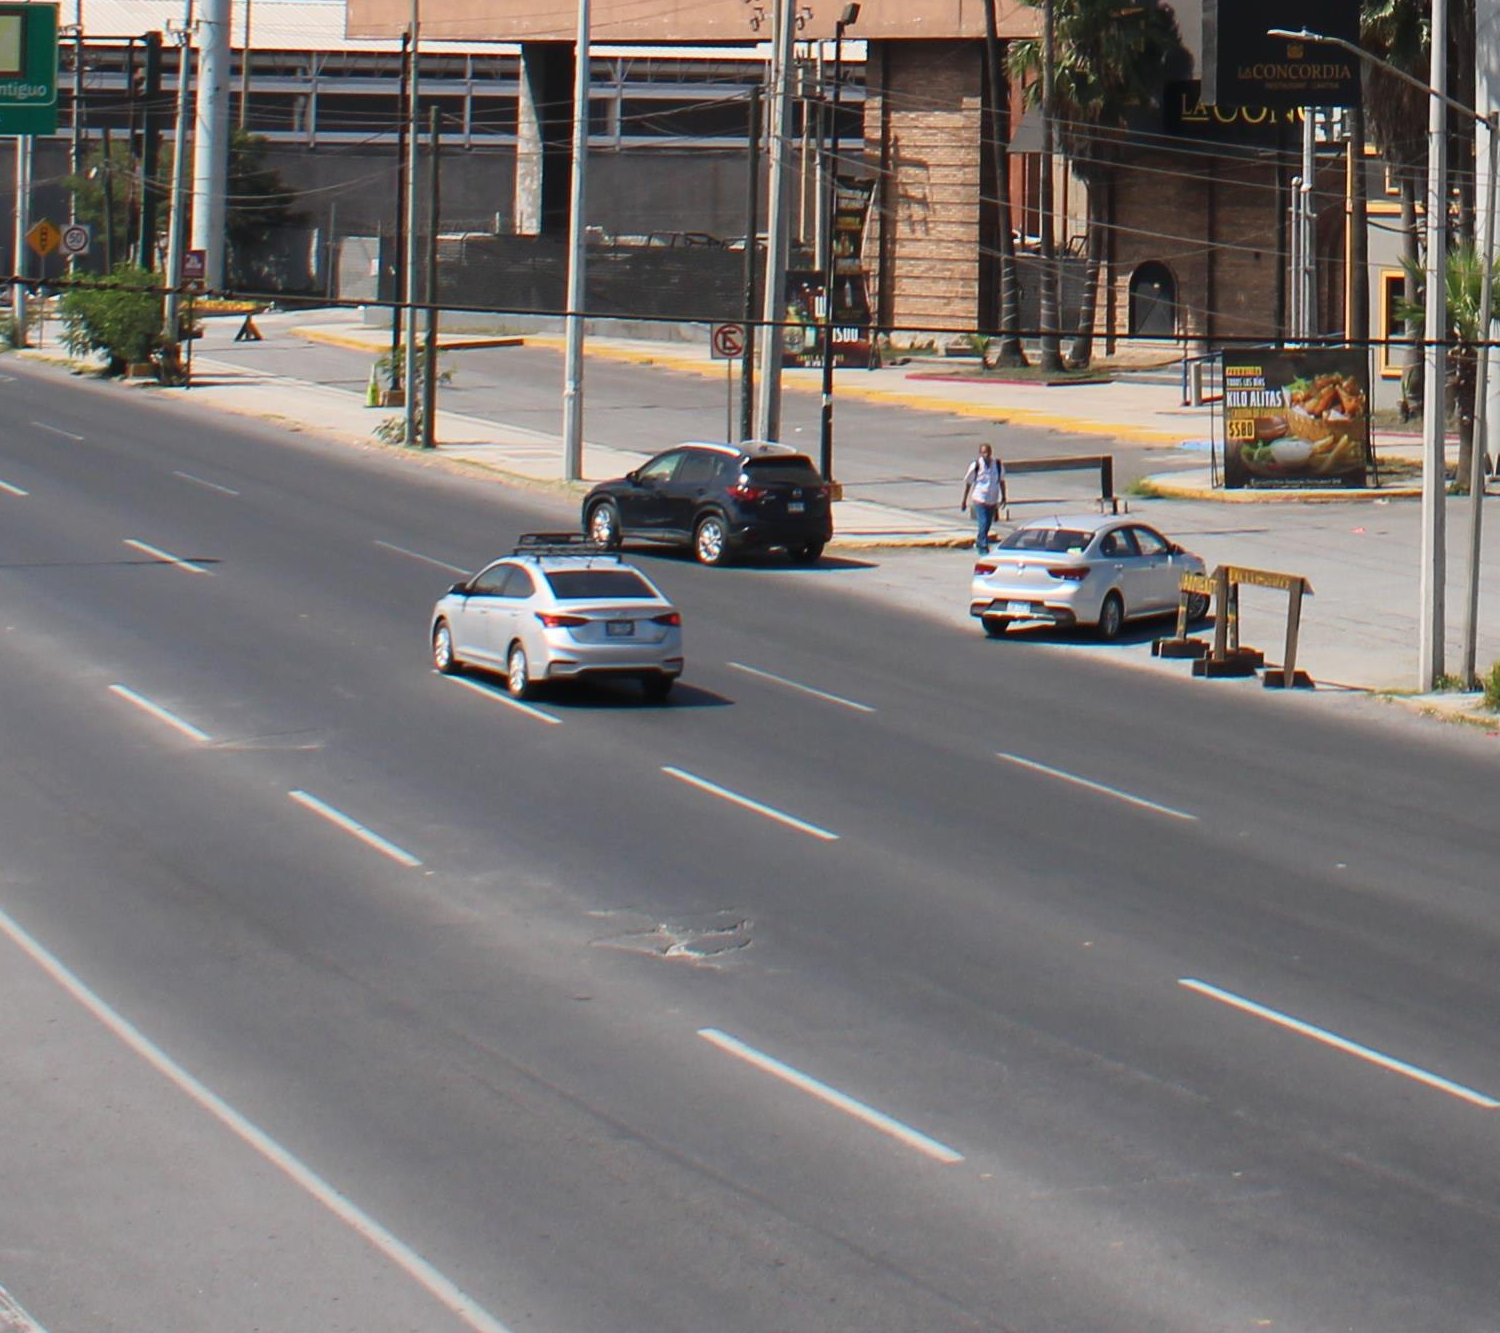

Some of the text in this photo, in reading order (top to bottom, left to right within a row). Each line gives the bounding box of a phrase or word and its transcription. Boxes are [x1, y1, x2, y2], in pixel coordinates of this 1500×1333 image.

[69, 233, 82, 244] 50
[1227, 390, 1282, 407] KILO ALITAS
